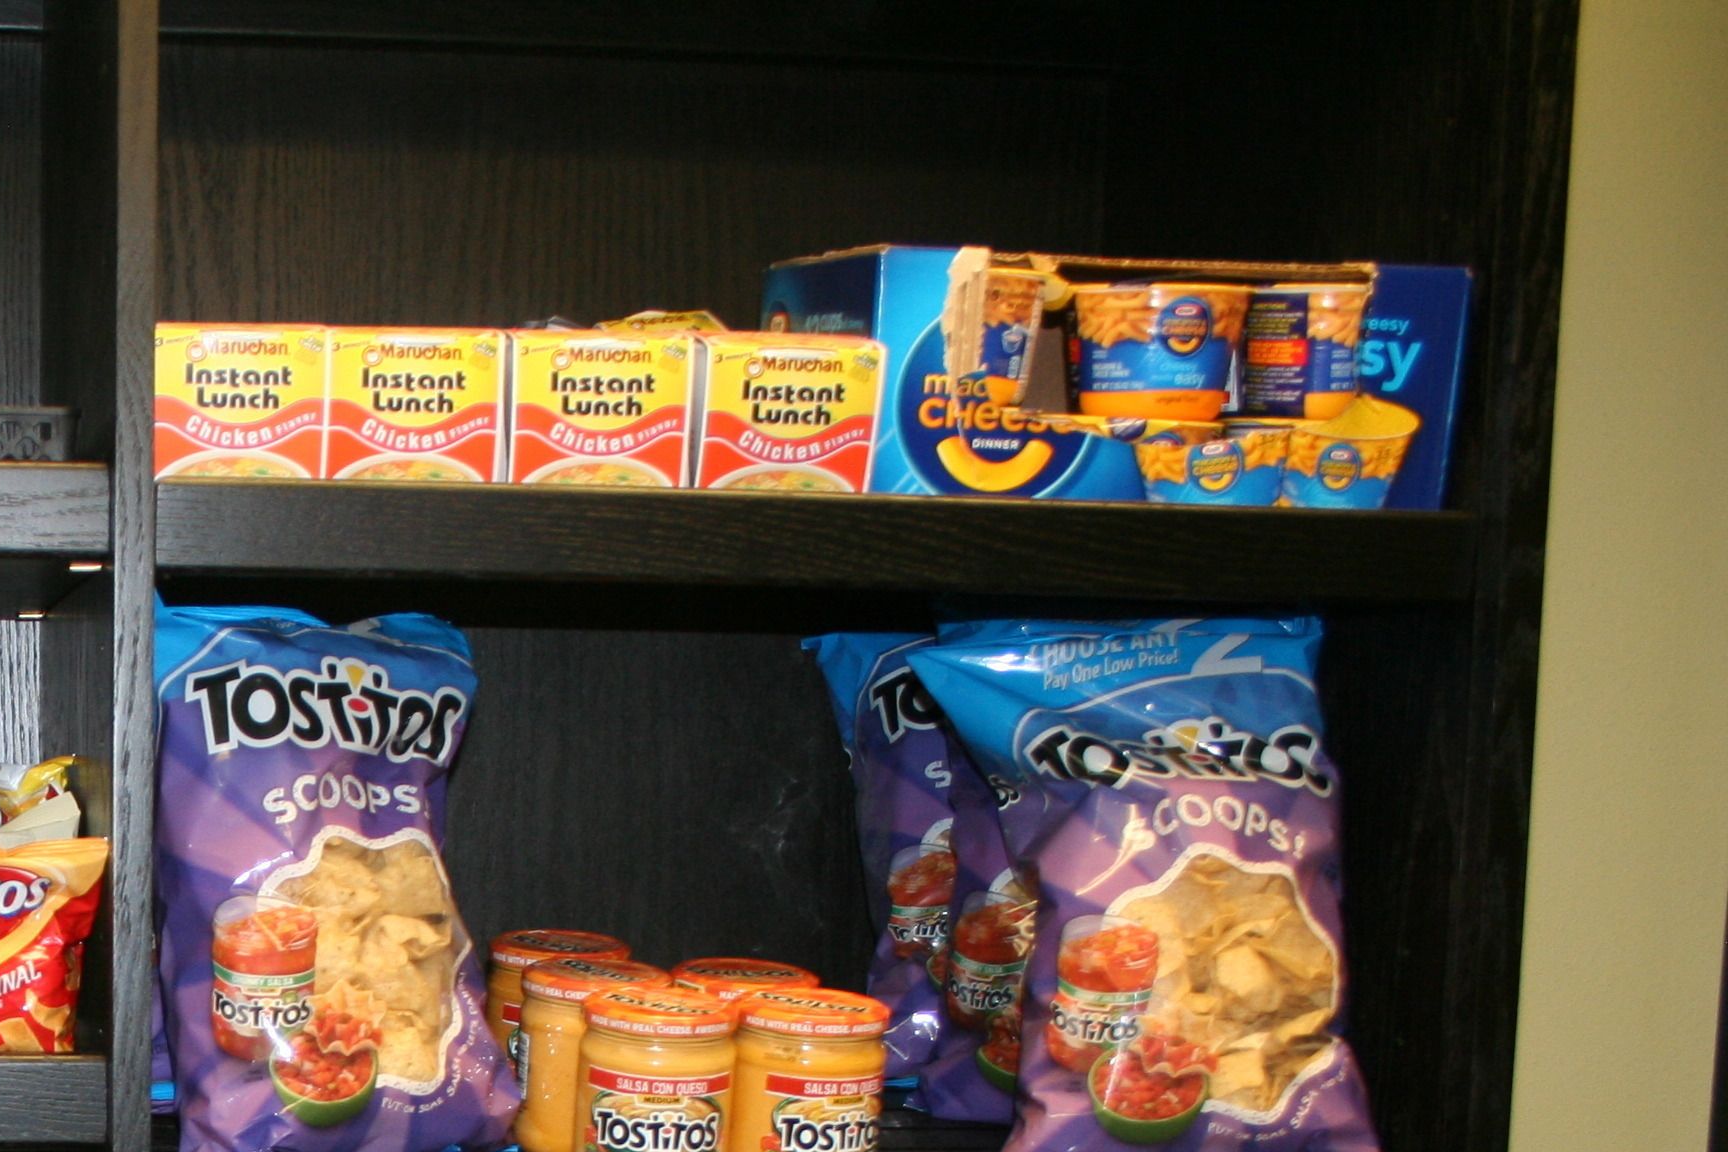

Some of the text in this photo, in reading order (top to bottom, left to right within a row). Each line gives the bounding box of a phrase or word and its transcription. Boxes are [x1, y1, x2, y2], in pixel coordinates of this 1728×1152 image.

[380, 343, 463, 361] Maruchan
[570, 347, 652, 363] Maruchan
[184, 363, 292, 386] Instant
[763, 356, 843, 373] Maruchan
[361, 367, 466, 390] Instant
[550, 372, 655, 395] Instant
[196, 387, 280, 410] Lunch
[372, 391, 454, 413] Lunch
[742, 380, 846, 404] Instant
[562, 395, 643, 417] Lunch
[751, 403, 831, 426] Lunch
[185, 415, 272, 449] Chicken
[361, 419, 446, 450] Chicken
[549, 421, 633, 453] Chicken
[972, 438, 1020, 449] DINNER
[738, 429, 821, 461] Chicken
[1043, 650, 1179, 690] Pay One Low Price!
[591, 1015, 655, 1034] MADE WITH REAL
[745, 1015, 812, 1033] MADE WITH REAL
[616, 1078, 708, 1094] SALSA CON QUESO
[804, 1081, 858, 1094] SALSA CON
